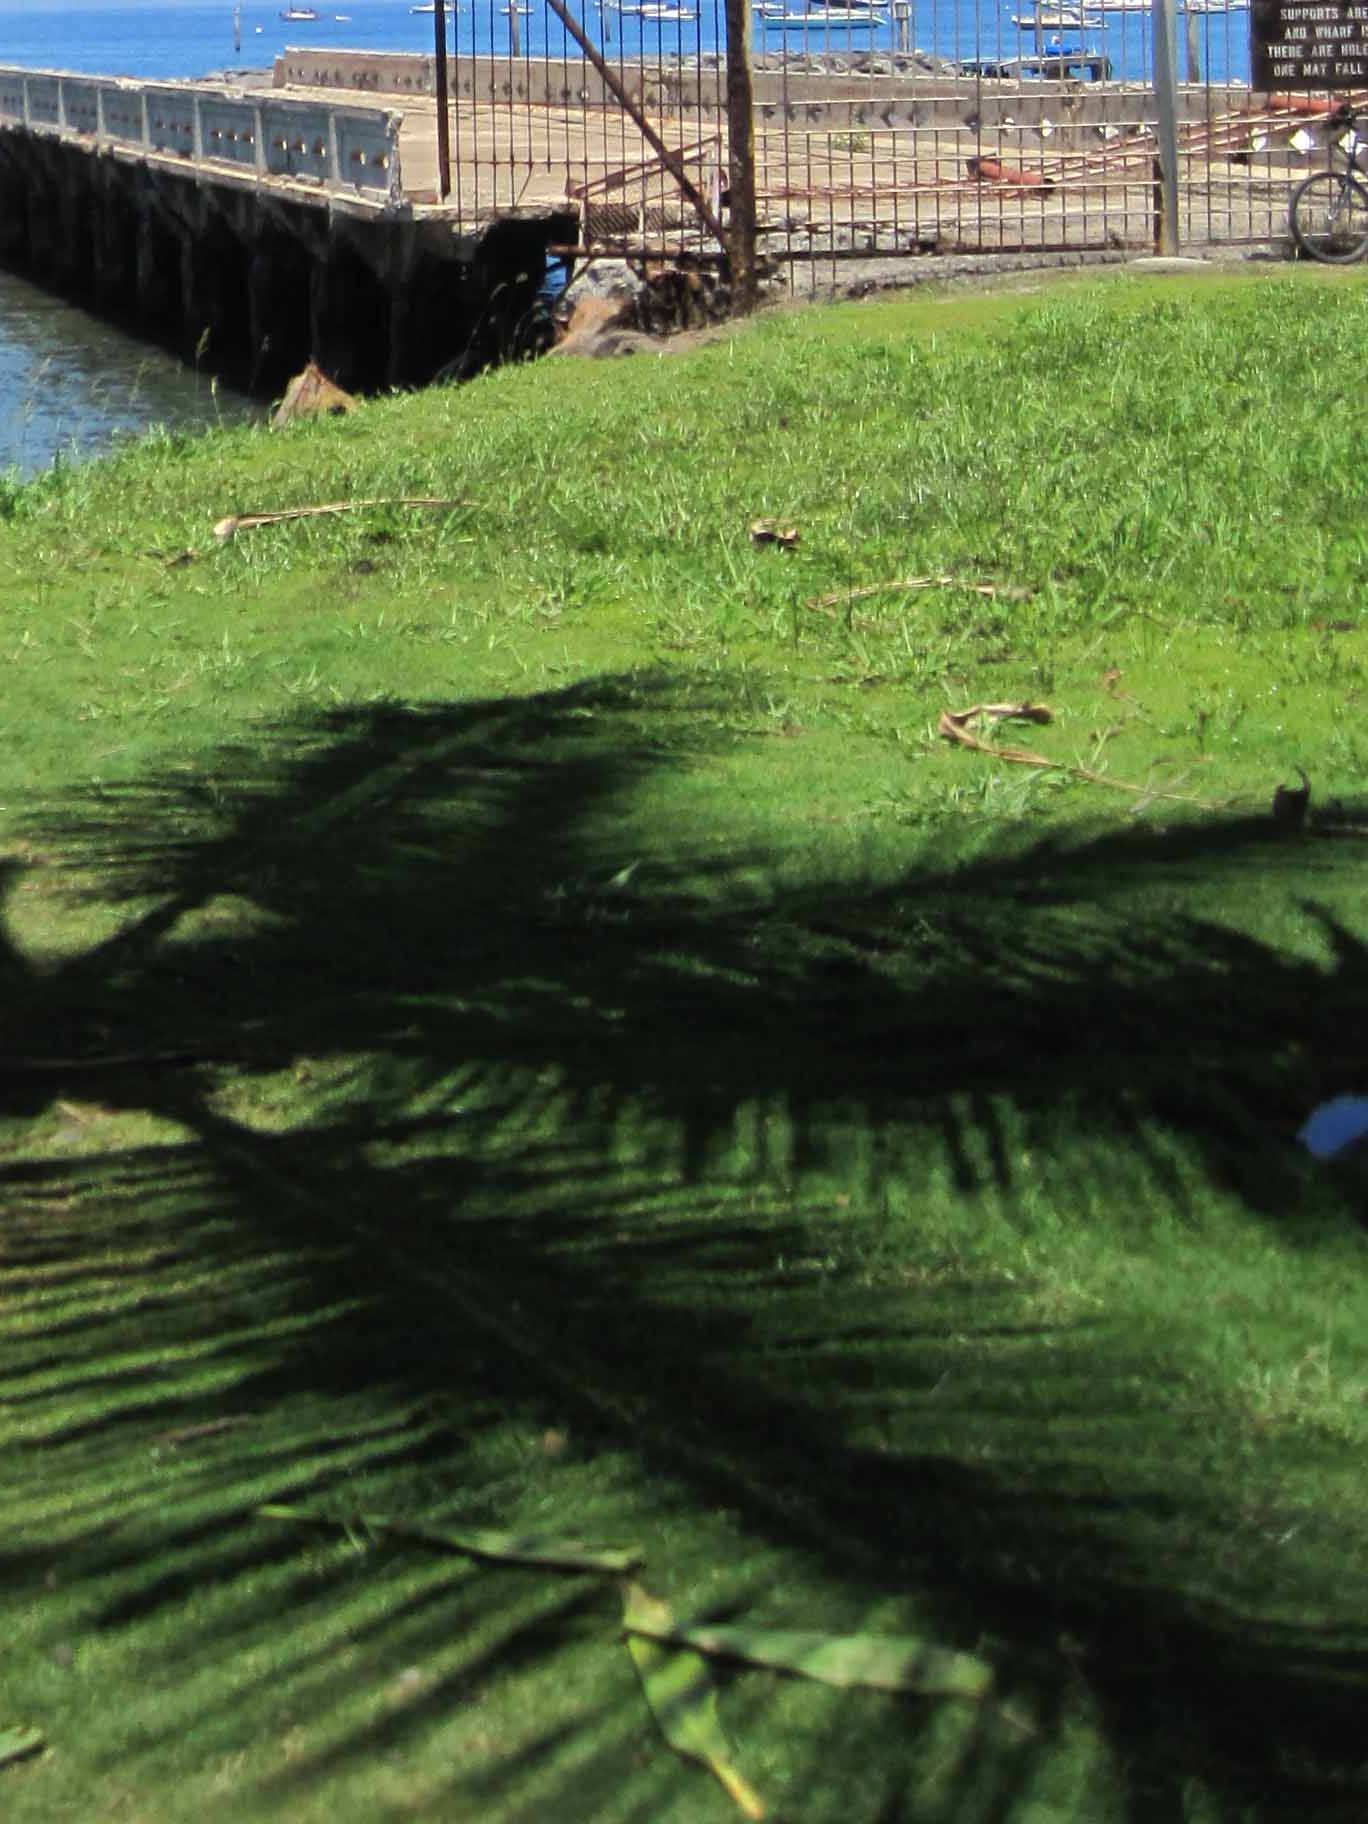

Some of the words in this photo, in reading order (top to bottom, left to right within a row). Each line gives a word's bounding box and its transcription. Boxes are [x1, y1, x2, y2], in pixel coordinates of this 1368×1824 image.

[1280, 7, 1339, 20] SUPPORTS
[1284, 26, 1307, 39] AND
[1315, 25, 1353, 39] WHARF
[1267, 45, 1304, 58] THERE
[1311, 44, 1334, 57] ARE
[1274, 64, 1296, 77] ONE
[1303, 63, 1327, 76] MAY
[1335, 62, 1364, 75] FALL
